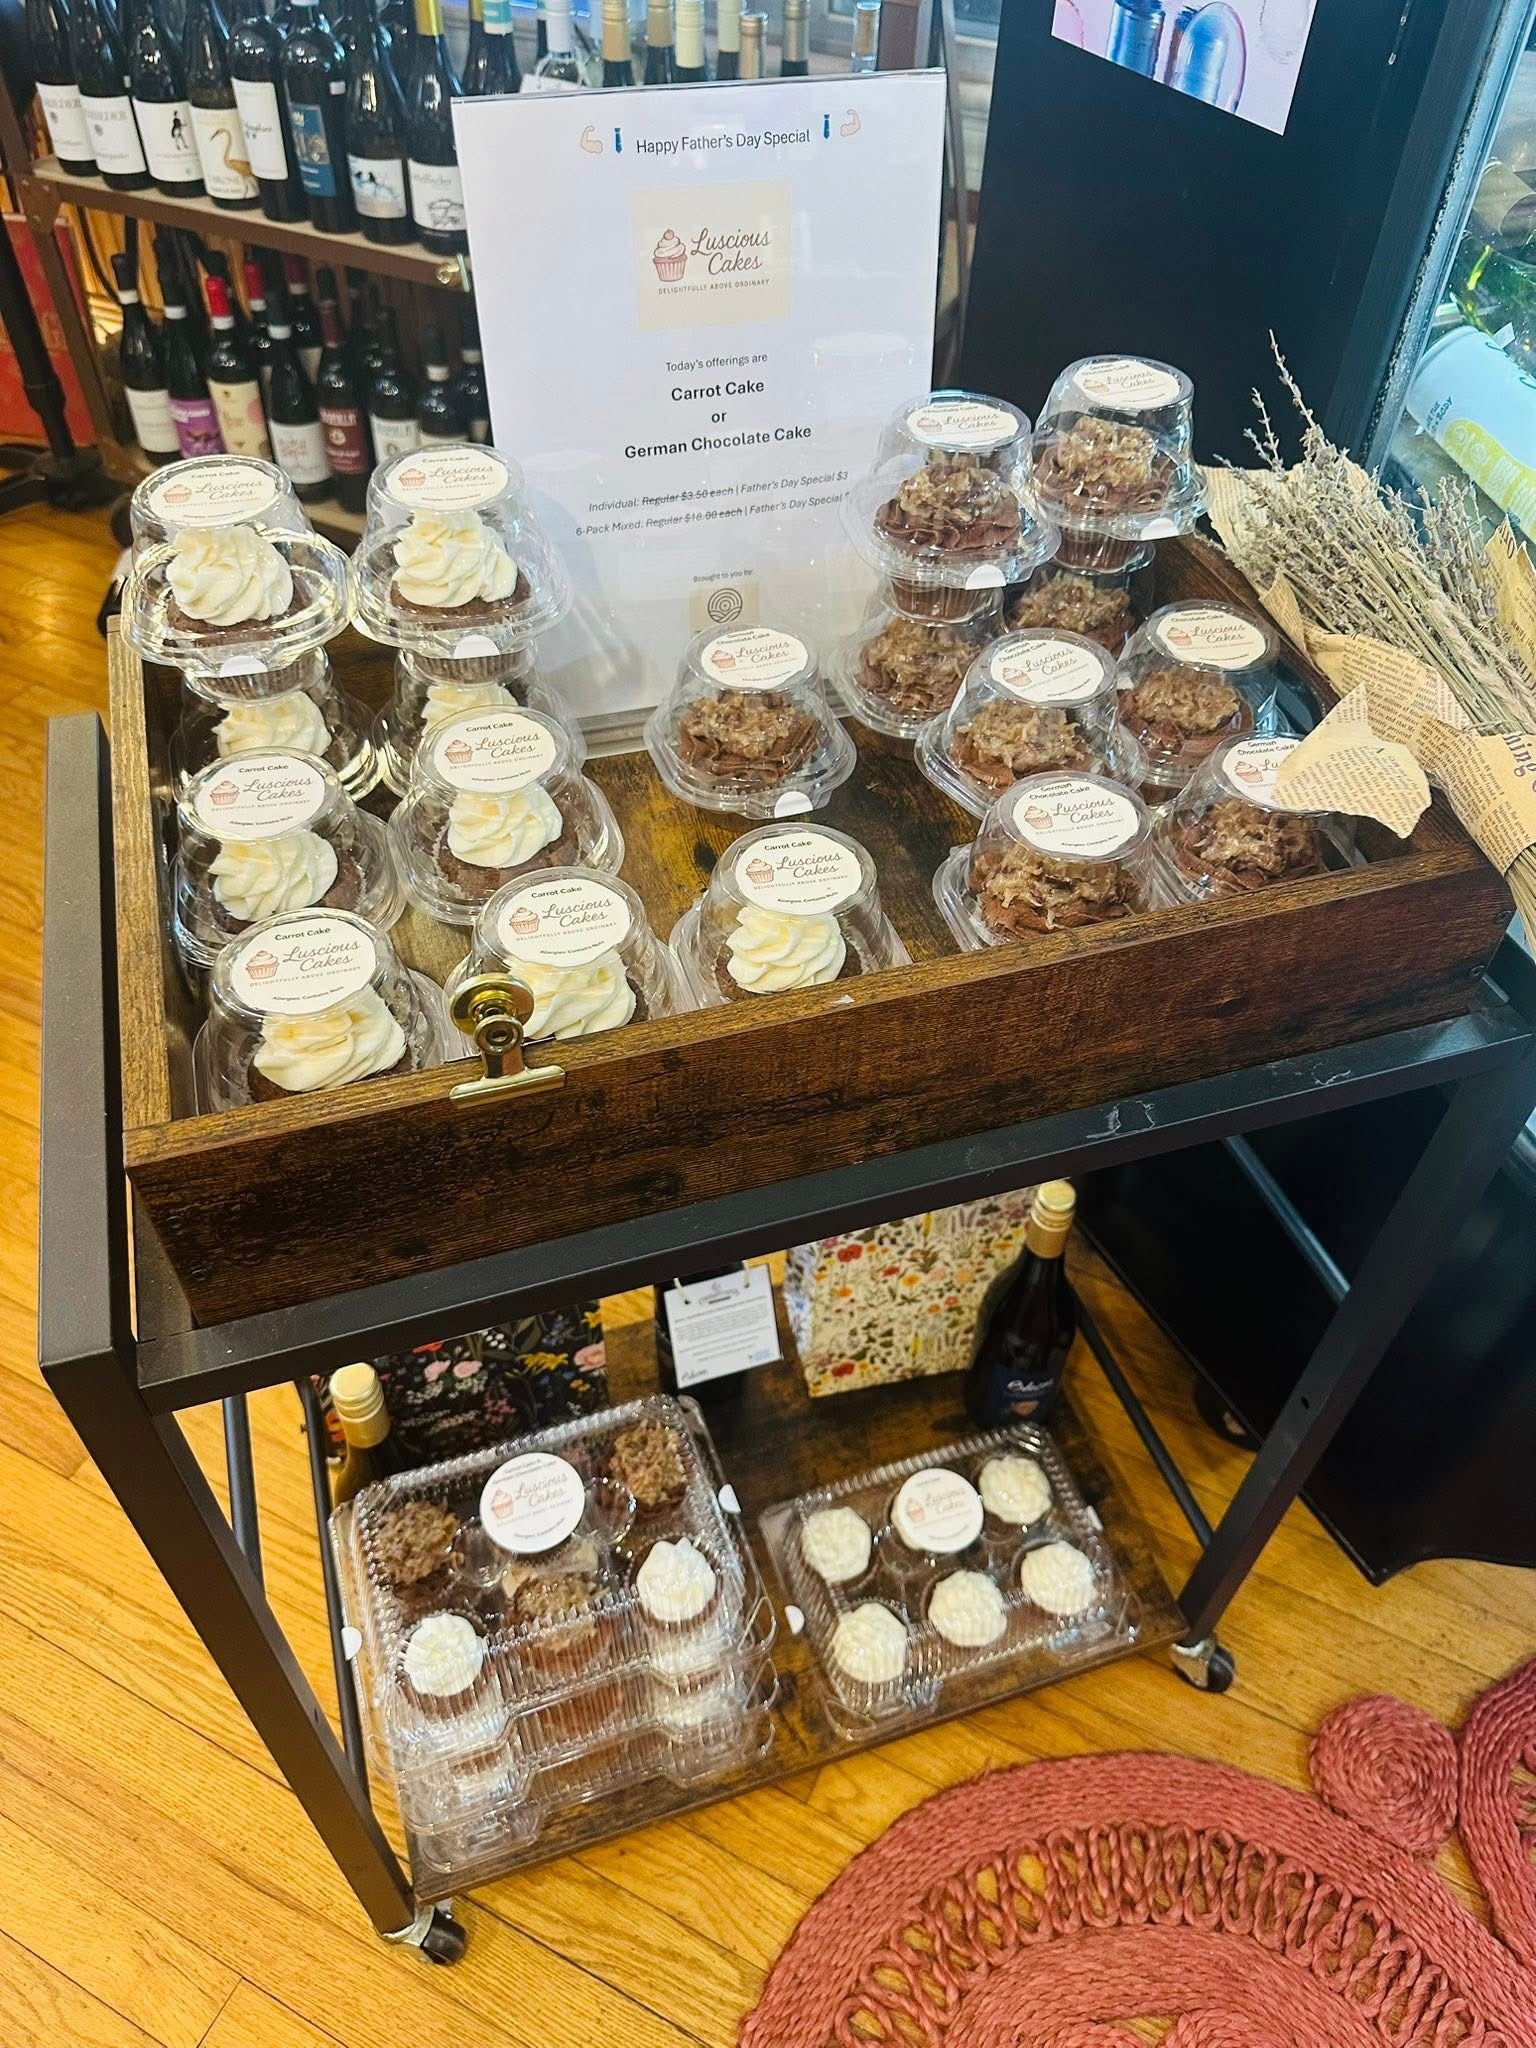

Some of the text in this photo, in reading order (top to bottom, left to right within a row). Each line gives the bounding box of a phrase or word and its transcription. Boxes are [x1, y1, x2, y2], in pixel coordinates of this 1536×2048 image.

[637, 129, 810, 155] Happy Father’s Day Special
[691, 227, 771, 255] Luscious
[708, 251, 763, 275] Cakes
[658, 279, 770, 295] DELIGHTFULLY ABOVE ORDINARY
[666, 353, 768, 373] Today’s offerings are
[671, 380, 765, 401] Carrot Cake
[711, 411, 727, 423] or
[624, 426, 812, 459] German Chocolate Cake
[430, 465, 494, 478] Luscious
[443, 474, 486, 484] Cakes
[195, 480, 263, 494] Luscious
[209, 490, 253, 500] Cakes
[589, 498, 640, 512] Individual:
[642, 492, 679, 506] Regular
[709, 486, 734, 498] each
[740, 480, 779, 494] Father’s
[781, 477, 800, 490] Day
[801, 473, 835, 487] Special
[576, 524, 610, 536] 6-Pack
[612, 519, 643, 532] Mixed:
[646, 515, 683, 529] Regular
[719, 507, 743, 518] each
[750, 501, 788, 516] Father’s
[789, 497, 807, 510] Day
[808, 493, 844, 508] Special
[693, 573, 721, 583] Brought
[730, 571, 743, 580] you
[1192, 624, 1246, 637] Luscious
[1206, 633, 1245, 643] Cakes
[735, 641, 791, 658] Luscious
[751, 650, 790, 664] Cakes
[1022, 648, 1073, 672] Luscious
[1042, 658, 1077, 676] Cakes
[466, 724, 492, 732] Carrot
[475, 733, 541, 750] Luscious
[491, 744, 536, 759] Cakes
[243, 777, 312, 792] Luscious
[1040, 783, 1072, 792] German
[256, 788, 305, 802] Cakes
[1029, 786, 1090, 801] Chocolate Cake
[1051, 797, 1116, 816] Luscious
[1070, 808, 1114, 824] Cakes
[764, 843, 789, 851] Carrot
[776, 852, 842, 870] Luscious
[793, 865, 839, 879] Cakes
[531, 886, 582, 898] Carrot Cake
[542, 897, 613, 919] Luscious
[559, 911, 608, 928] Cakes
[275, 927, 331, 941] Carrot Cake
[282, 940, 360, 963] Luscious
[300, 954, 353, 972] Cakes
